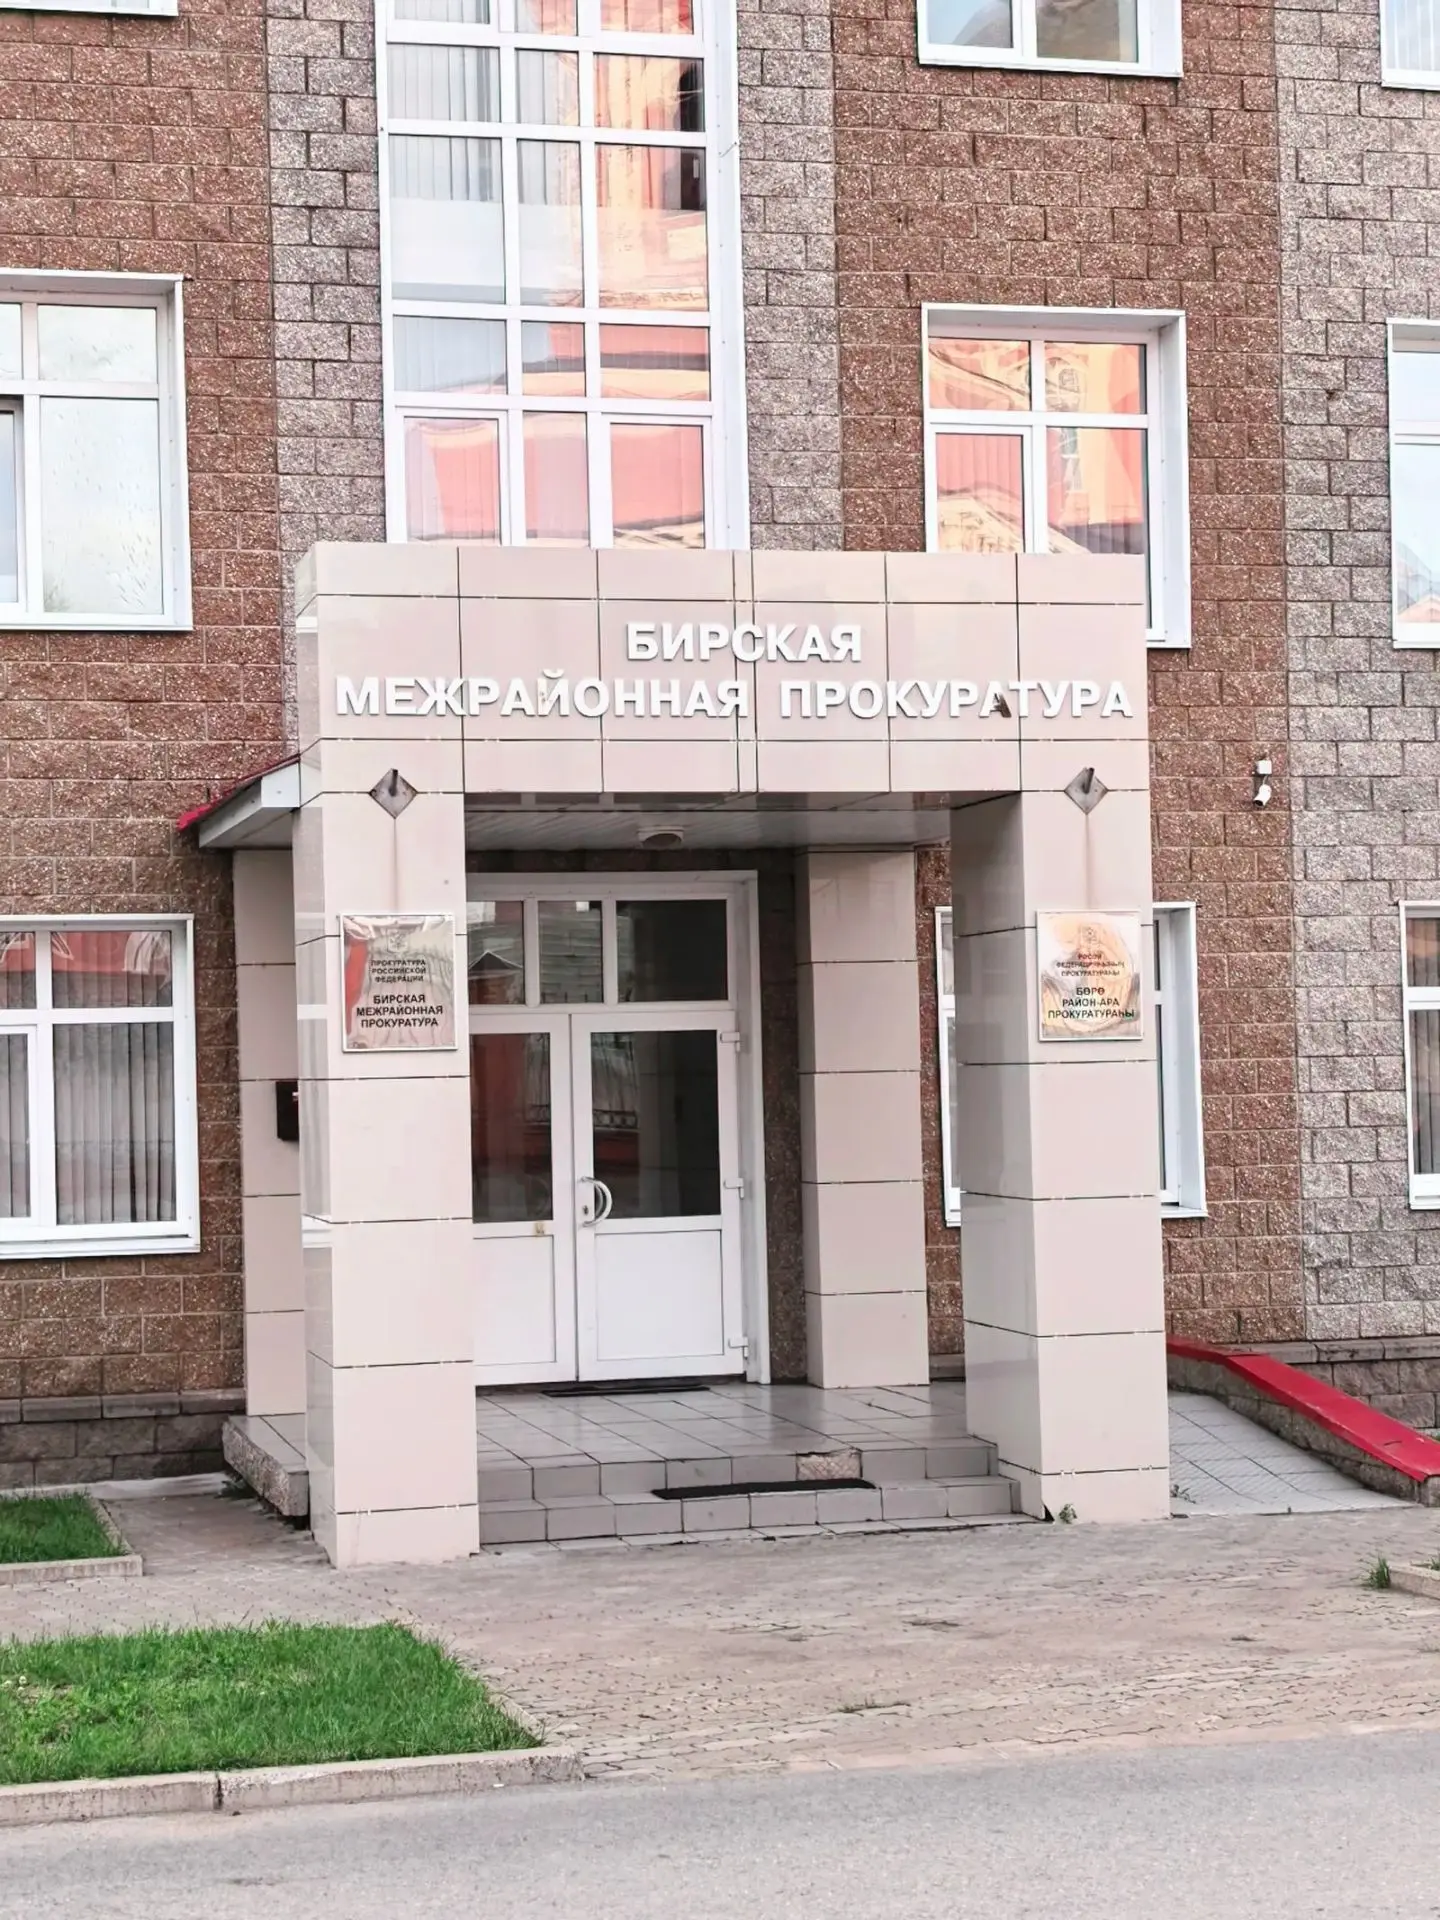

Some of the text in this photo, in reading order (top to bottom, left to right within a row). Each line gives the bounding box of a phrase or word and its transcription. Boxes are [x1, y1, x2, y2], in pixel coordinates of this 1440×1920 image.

[626, 621, 863, 663] БИРСКАЯ
[335, 669, 1133, 719] МЕЖРАЙОННАЯ ПРОКУРАТУРА
[375, 975, 424, 983] ФЕДЕРАЦИИ
[373, 994, 426, 1004] БИРСКАЯ
[1062, 997, 1120, 1007] РАЙОН-АРА
[356, 1005, 443, 1016] МЕЖРАЙОННАЯ
[361, 1018, 438, 1028] ПРОКУРАТУРА
